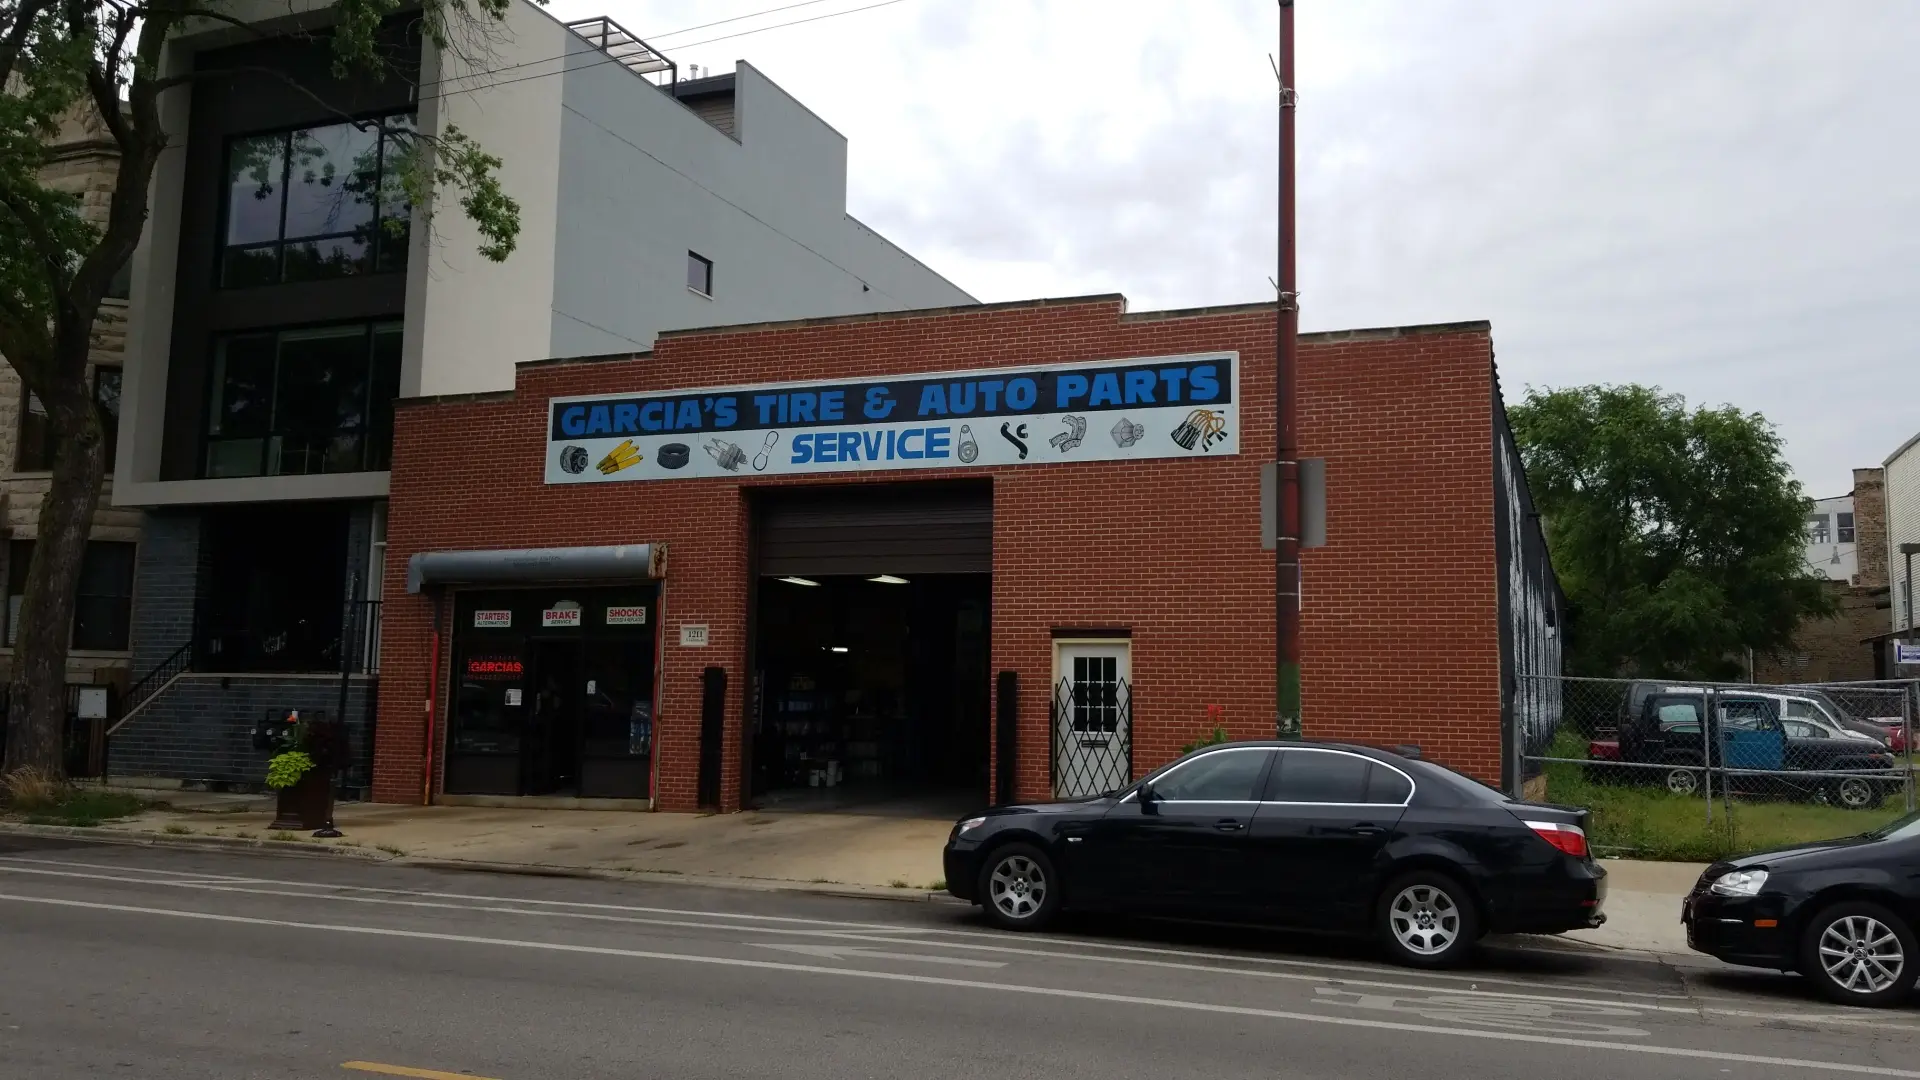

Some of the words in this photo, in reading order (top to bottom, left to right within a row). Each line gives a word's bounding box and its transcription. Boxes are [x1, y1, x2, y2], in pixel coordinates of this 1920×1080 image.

[561, 397, 738, 436] GARCIA'S
[754, 391, 844, 424] TIRE
[864, 387, 897, 419] &
[917, 377, 1037, 416] AUTO
[1057, 365, 1220, 408] PARTS
[791, 427, 950, 464] SERVICE
[476, 612, 509, 620] STARTERS
[545, 610, 578, 619] BRAKE
[609, 608, 644, 617] SHOCKS
[471, 661, 521, 672] GARCIAS
